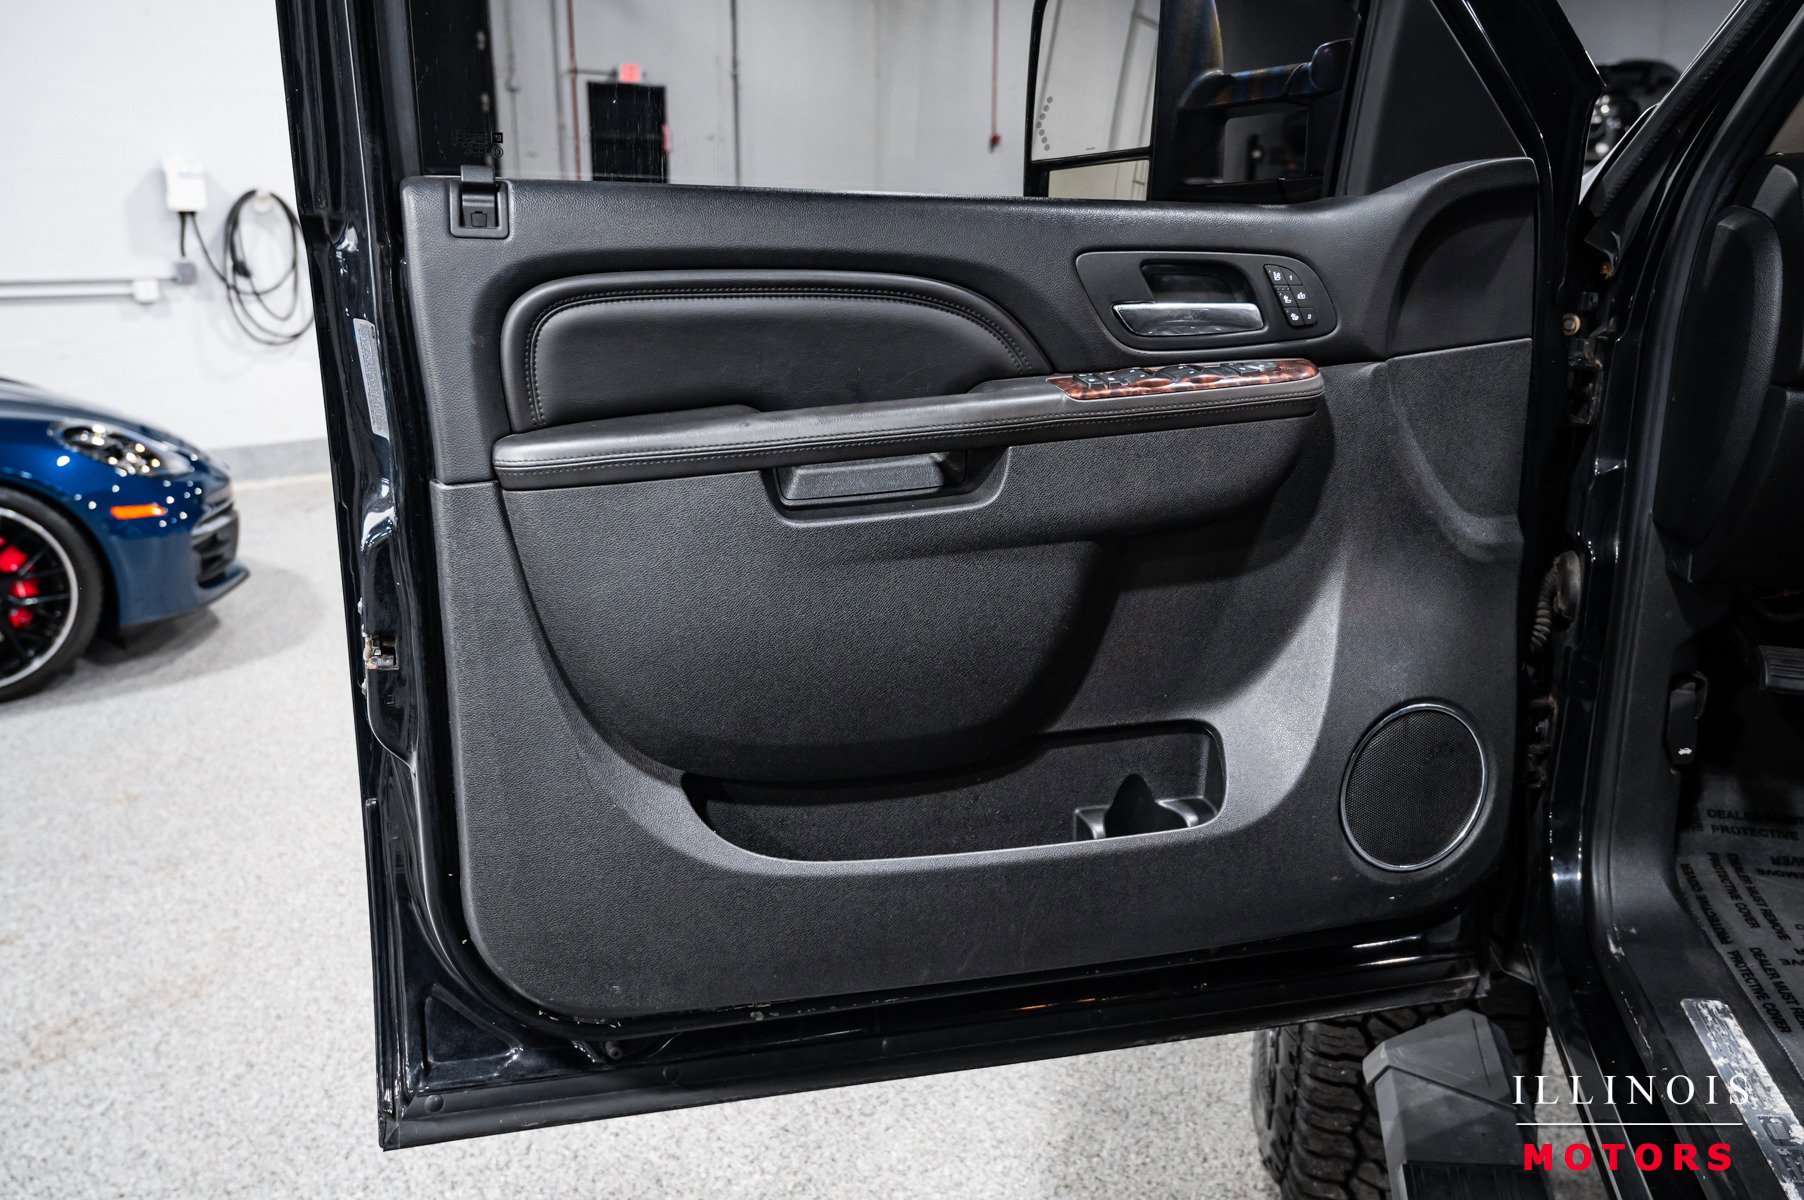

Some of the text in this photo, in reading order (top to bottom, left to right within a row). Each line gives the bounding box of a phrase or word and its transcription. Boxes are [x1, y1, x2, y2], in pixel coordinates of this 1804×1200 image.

[1711, 824, 1799, 841] PROTECTIVE
[1680, 863, 1703, 893] COVER
[1707, 852, 1761, 929] PROTECTIVE COVER
[1695, 893, 1733, 945] PROTECTIVE
[1745, 884, 1768, 908] MUST
[1759, 907, 1792, 941] REMOVE
[1727, 950, 1771, 1000] PROTECTIVE
[1762, 1002, 1792, 1034] COVER
[1749, 947, 1780, 980] DEALER
[1772, 980, 1800, 1006] MUST
